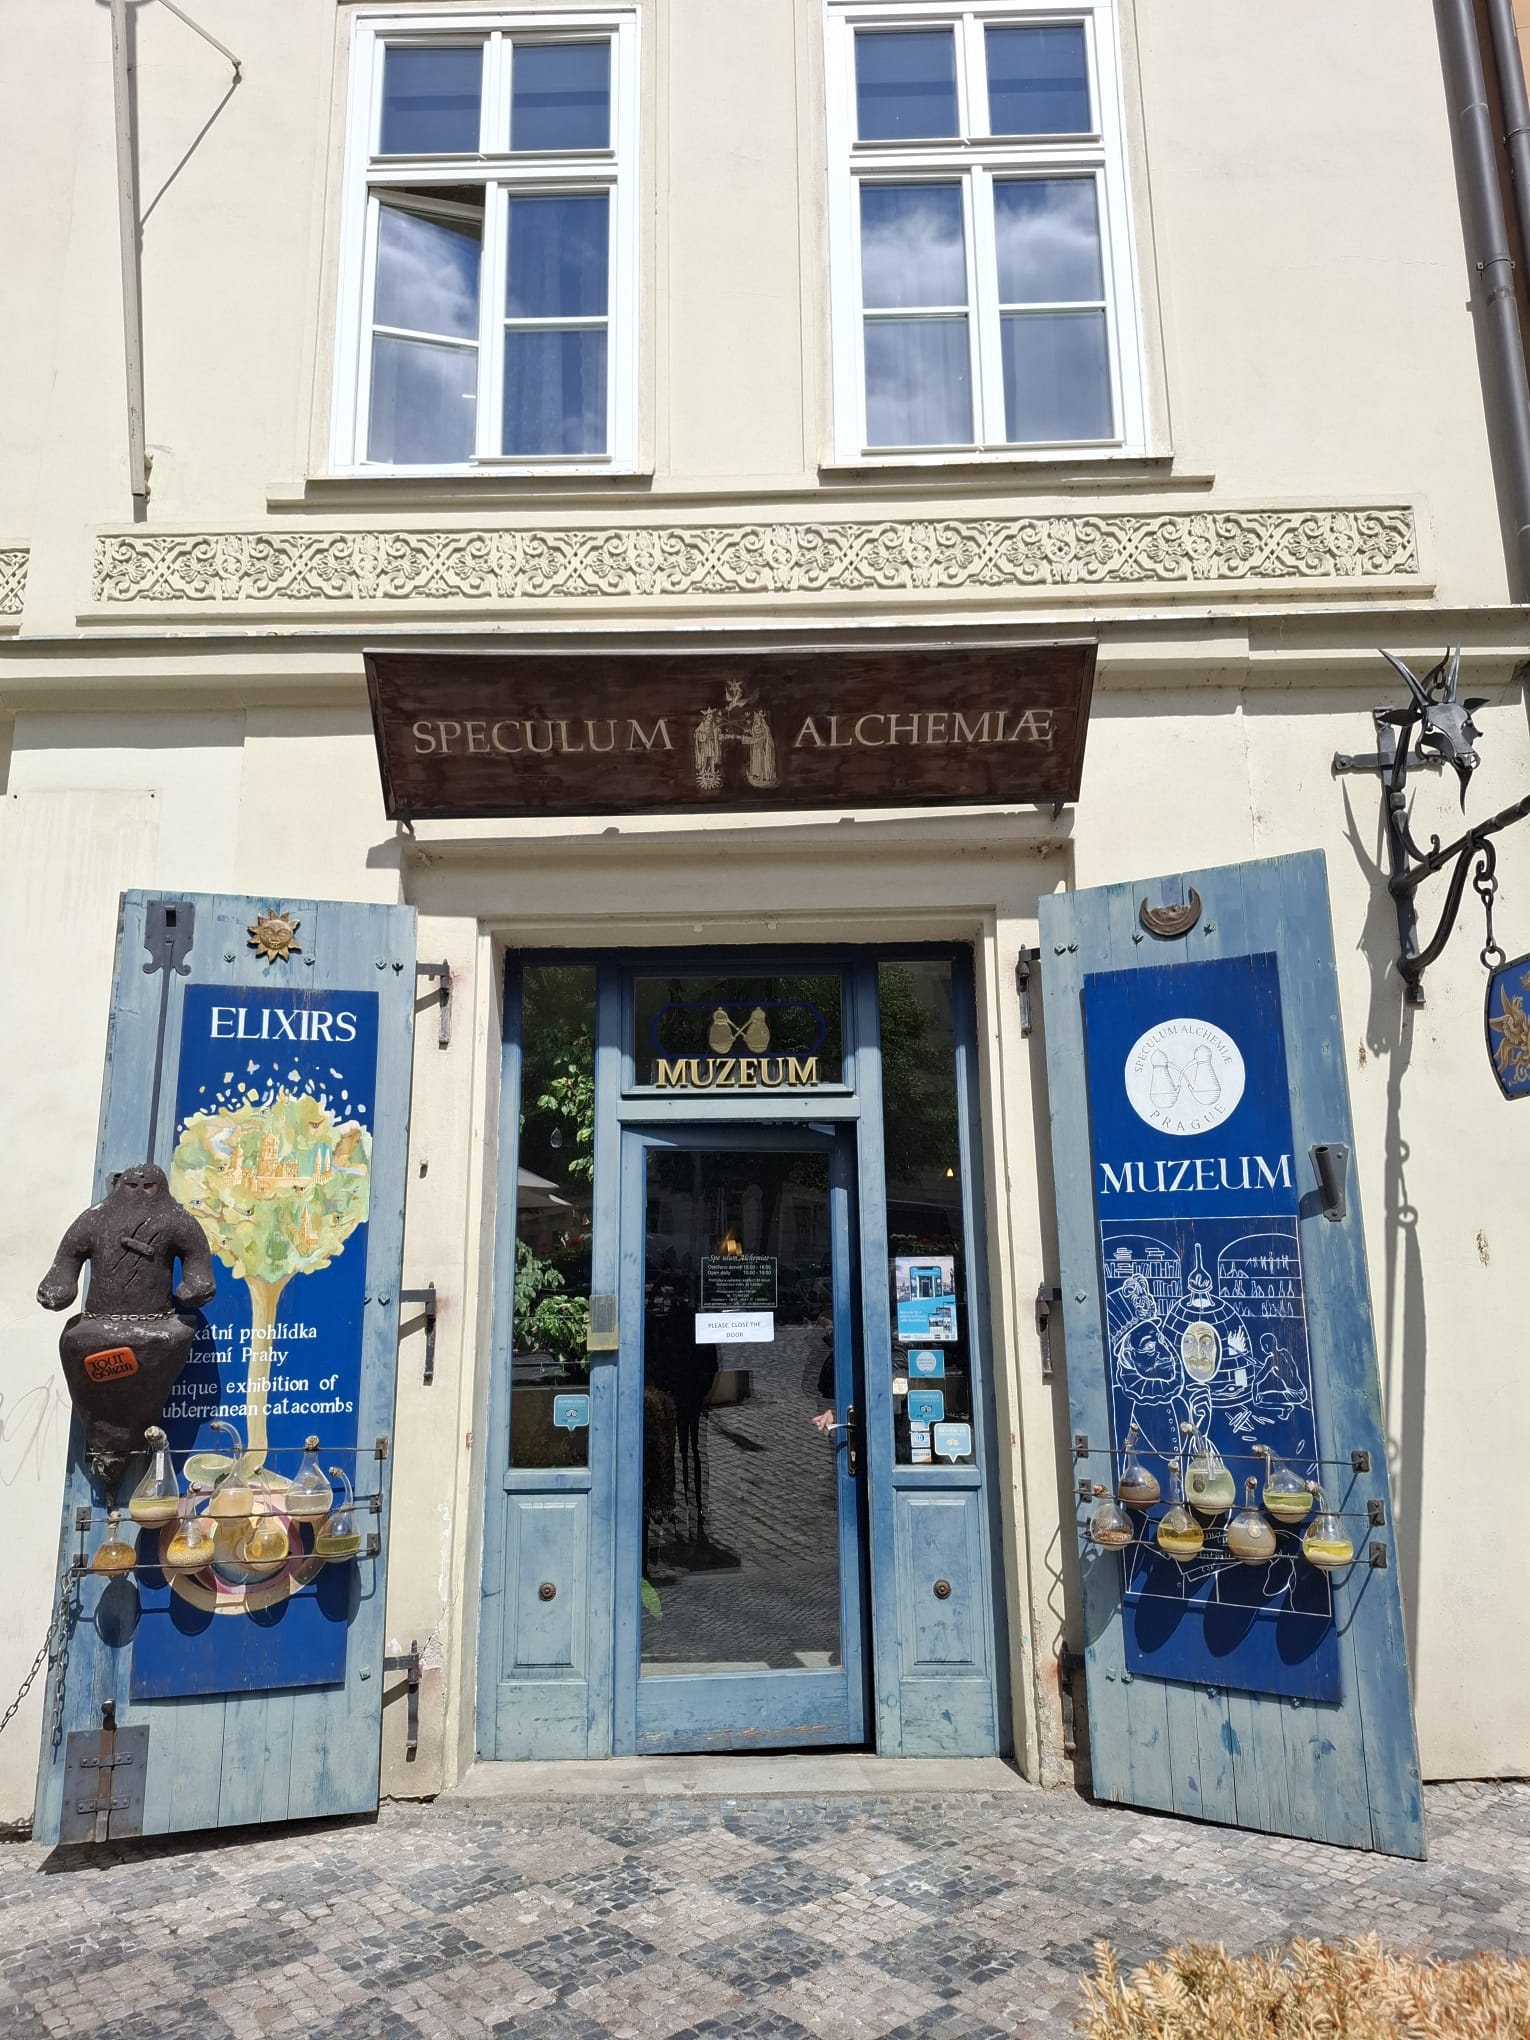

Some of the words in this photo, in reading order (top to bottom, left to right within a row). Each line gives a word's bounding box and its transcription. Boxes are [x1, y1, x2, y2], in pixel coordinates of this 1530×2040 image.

[412, 718, 675, 754] SPECULUM
[794, 709, 1056, 748] ALCHEMIÆ
[209, 1006, 357, 1042] ELIXIRS
[1134, 1025, 1178, 1073] SPECULUM
[655, 1056, 819, 1089] MUZEUM
[1149, 1103, 1226, 1131] PRAGUE
[1100, 1154, 1294, 1194] MUZEUM
[240, 1322, 318, 1345] prohlídka
[241, 1347, 289, 1366] Prahy
[169, 1380, 218, 1400] nique
[225, 1378, 310, 1394] exhibition
[319, 1374, 339, 1391] of
[162, 1400, 258, 1418] ubterranean
[262, 1397, 354, 1416] catacombs
